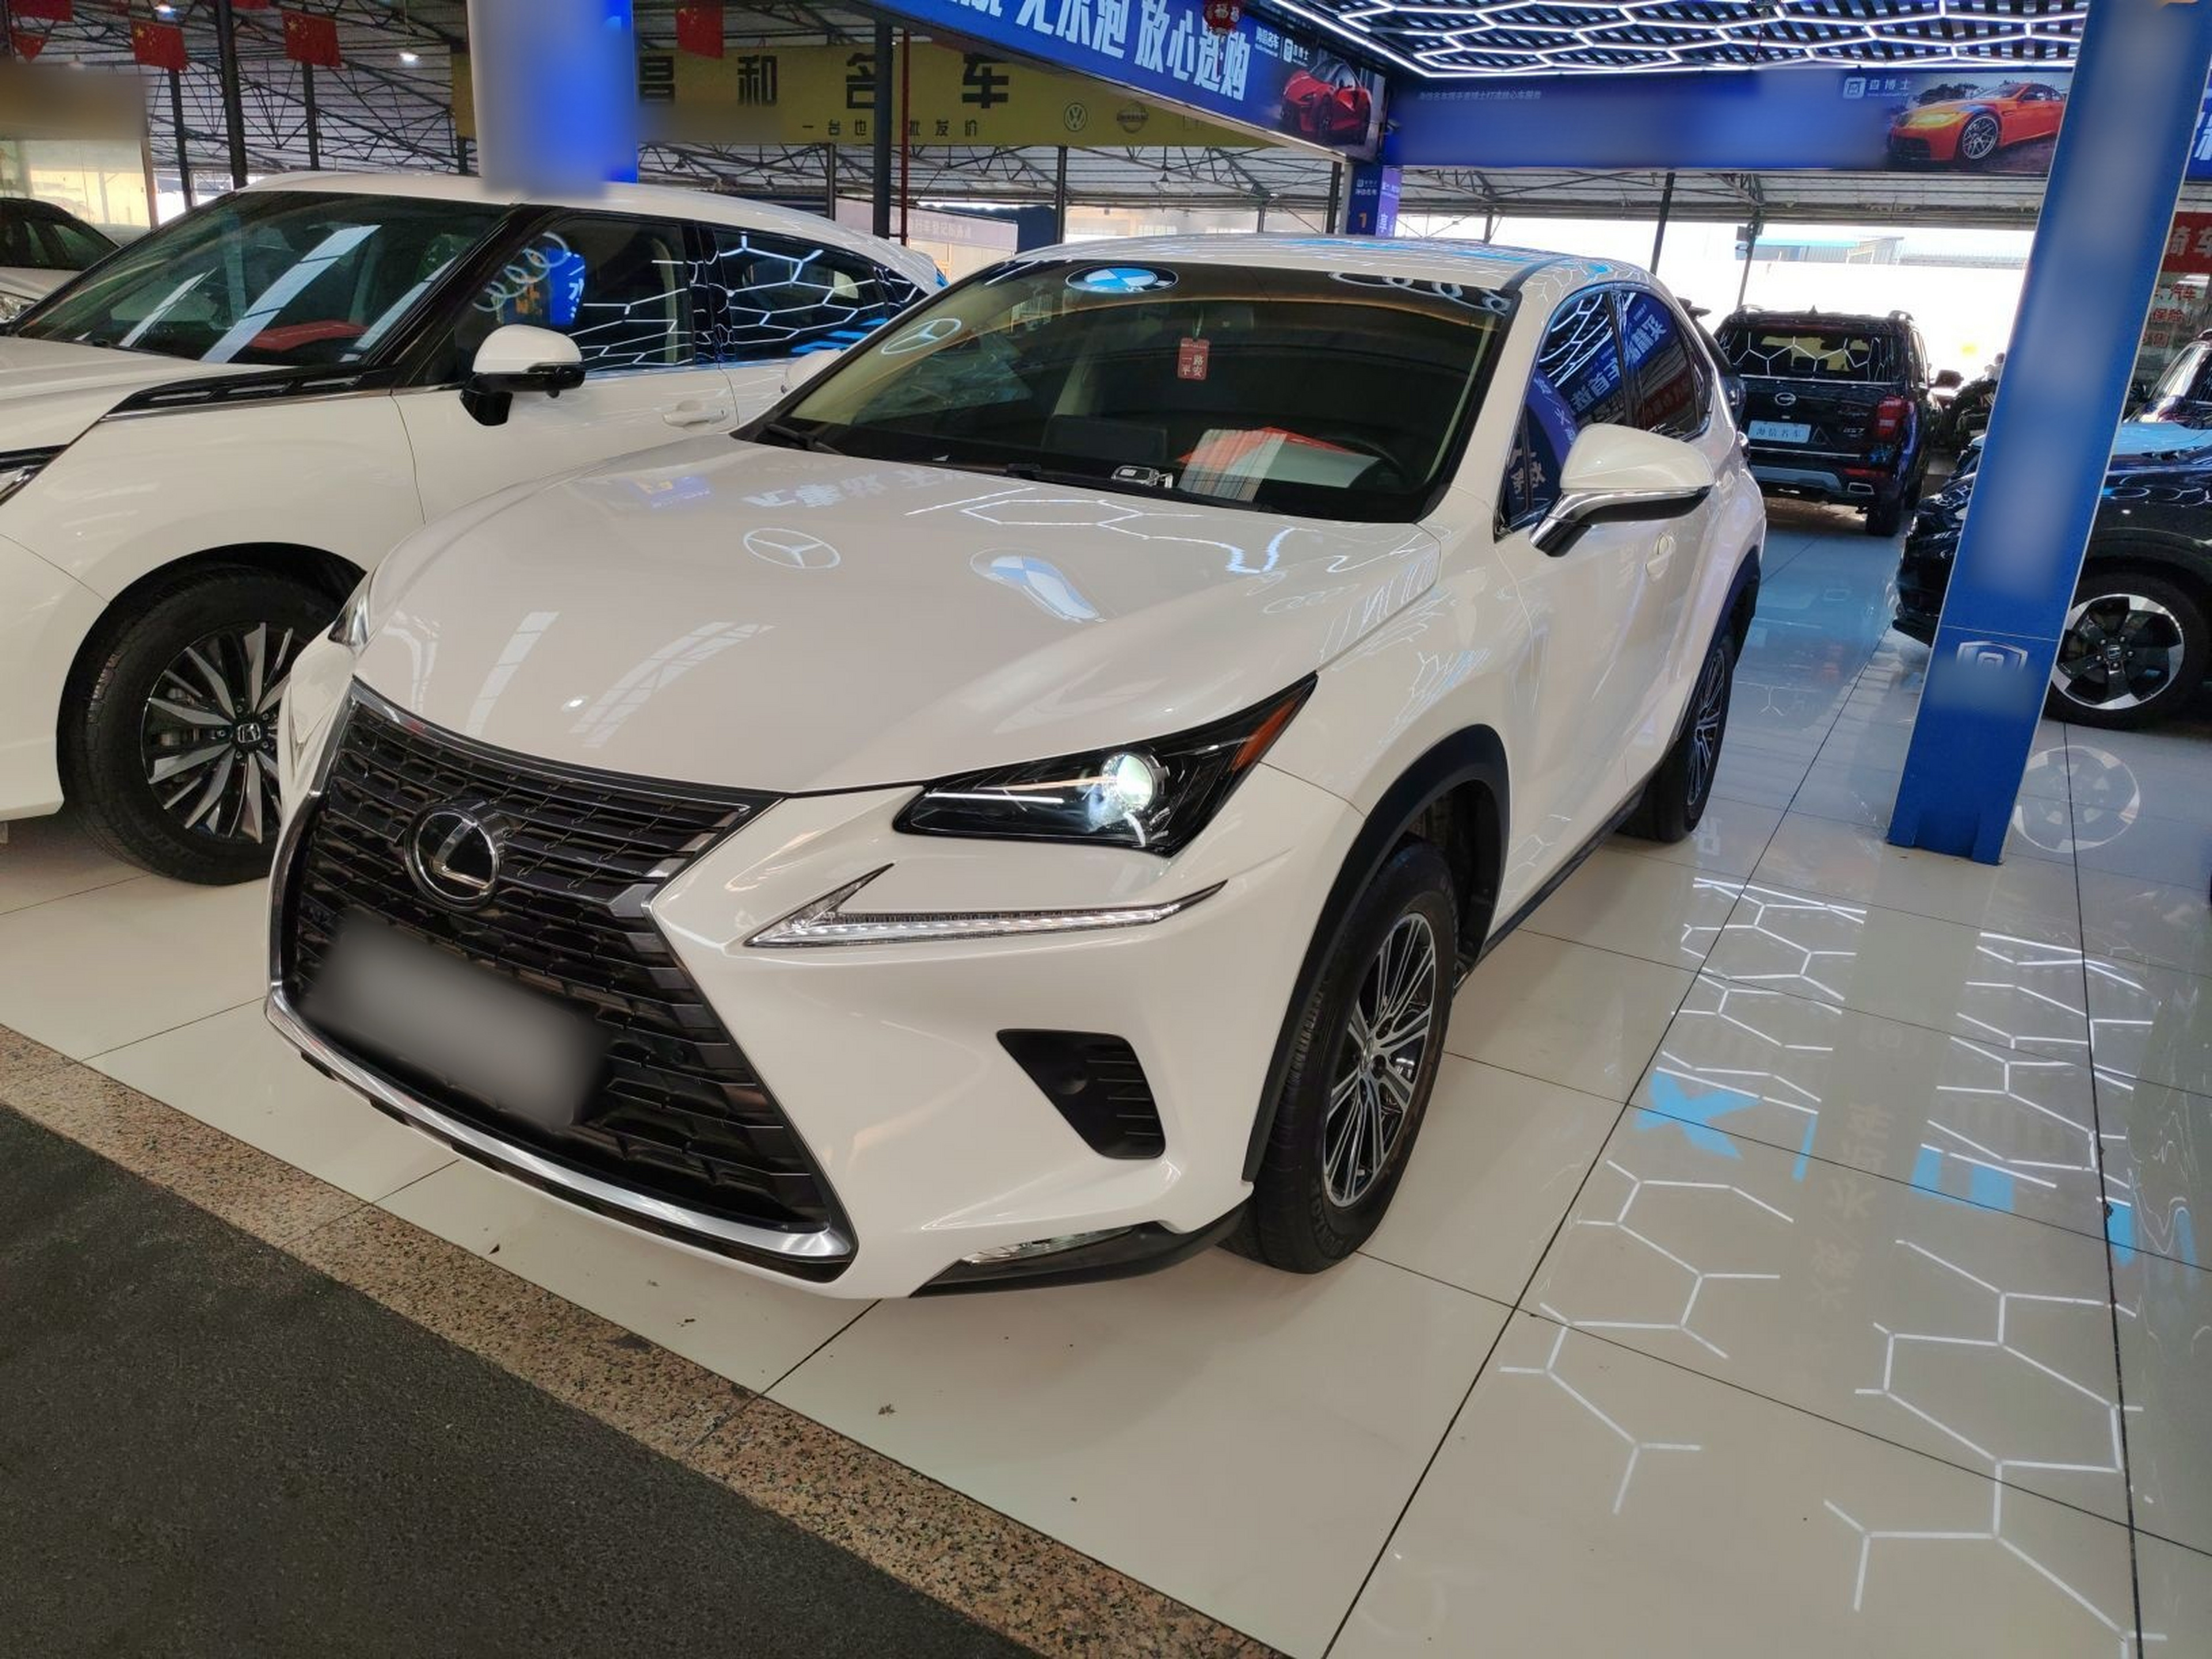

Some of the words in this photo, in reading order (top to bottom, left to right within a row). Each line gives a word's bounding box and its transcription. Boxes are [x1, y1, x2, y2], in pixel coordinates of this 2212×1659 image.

[1134, 0, 1251, 101] 放心选购
[802, 119, 978, 137] 一台也批发价
